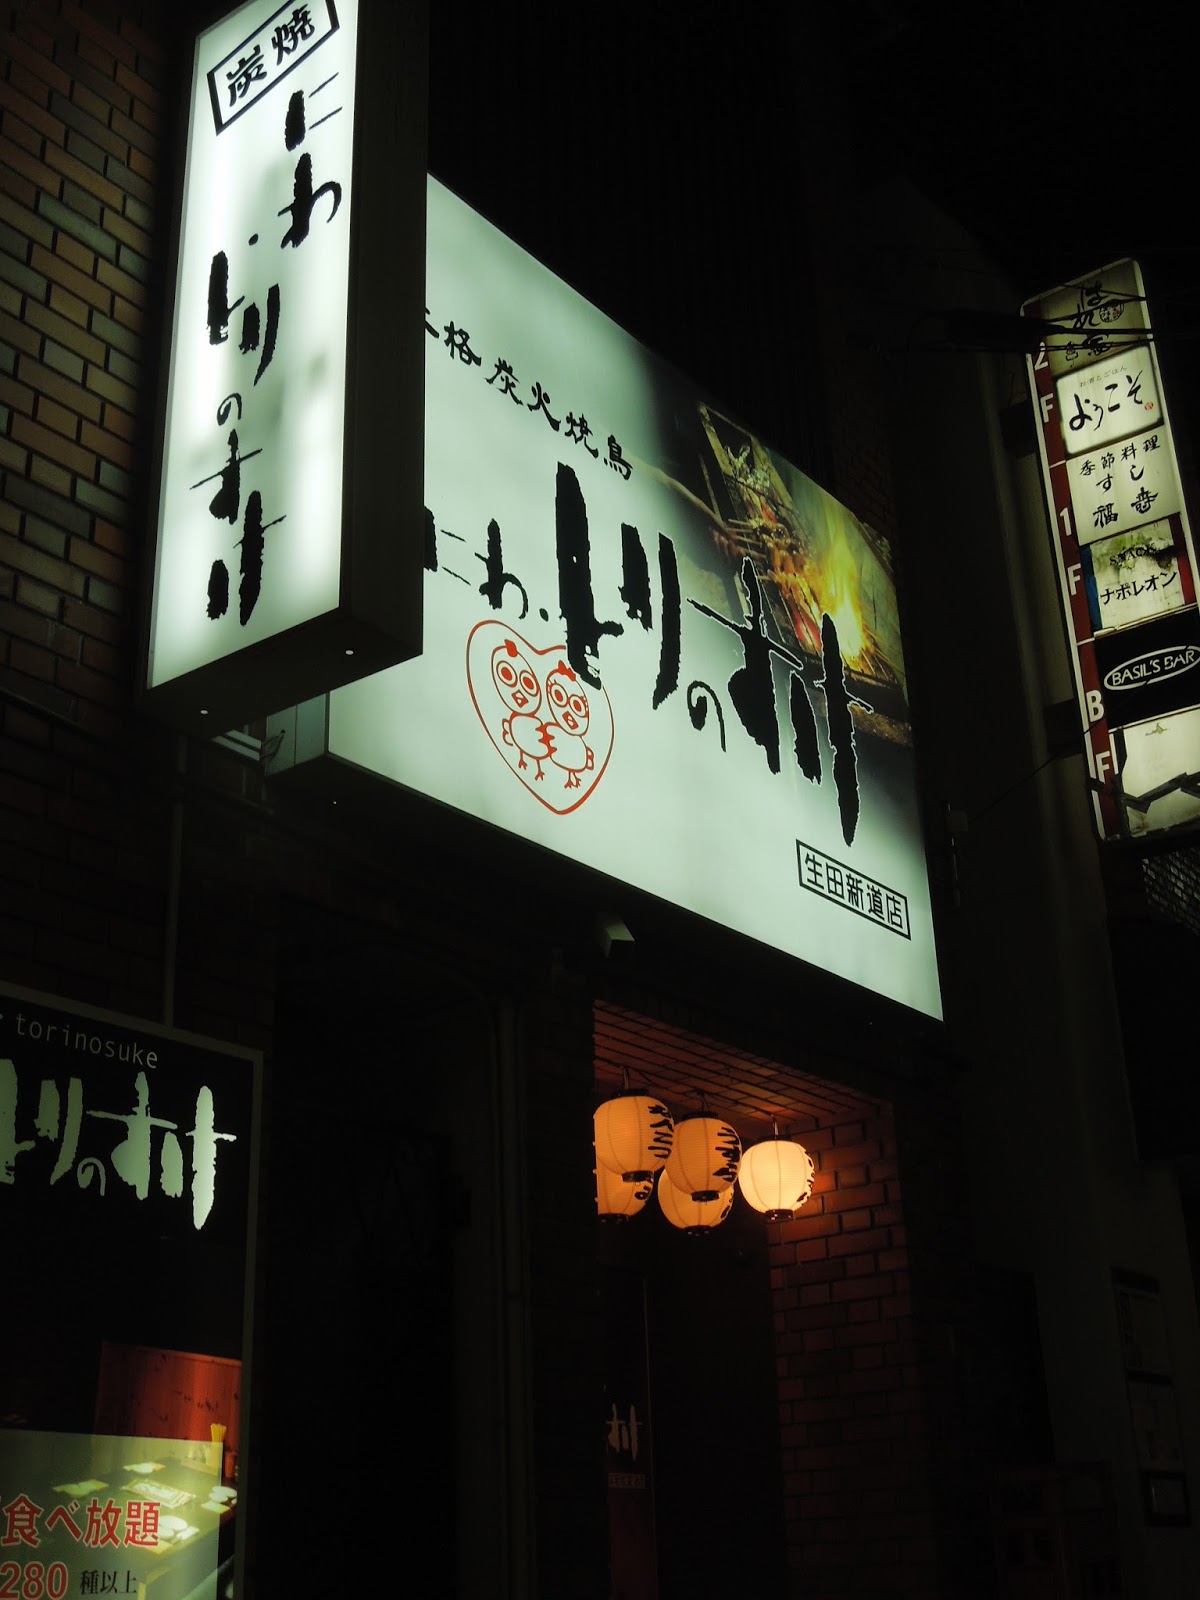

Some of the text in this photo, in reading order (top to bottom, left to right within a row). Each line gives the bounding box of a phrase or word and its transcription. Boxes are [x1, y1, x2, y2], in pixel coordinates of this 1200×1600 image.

[226, 4, 316, 107] 炭焼
[1069, 370, 1143, 431] ようこそ
[1079, 435, 1160, 475] 季節料理
[1096, 464, 1145, 494] すし
[1100, 571, 1177, 605] ナポレオン
[1112, 650, 1195, 686] BASIL'S BAR
[804, 852, 904, 930] 生田新道店
[16, 1012, 158, 1069] torinosuke
[1, 1494, 161, 1548] 食べ放題
[0, 1561, 137, 1600] 280 種以上
